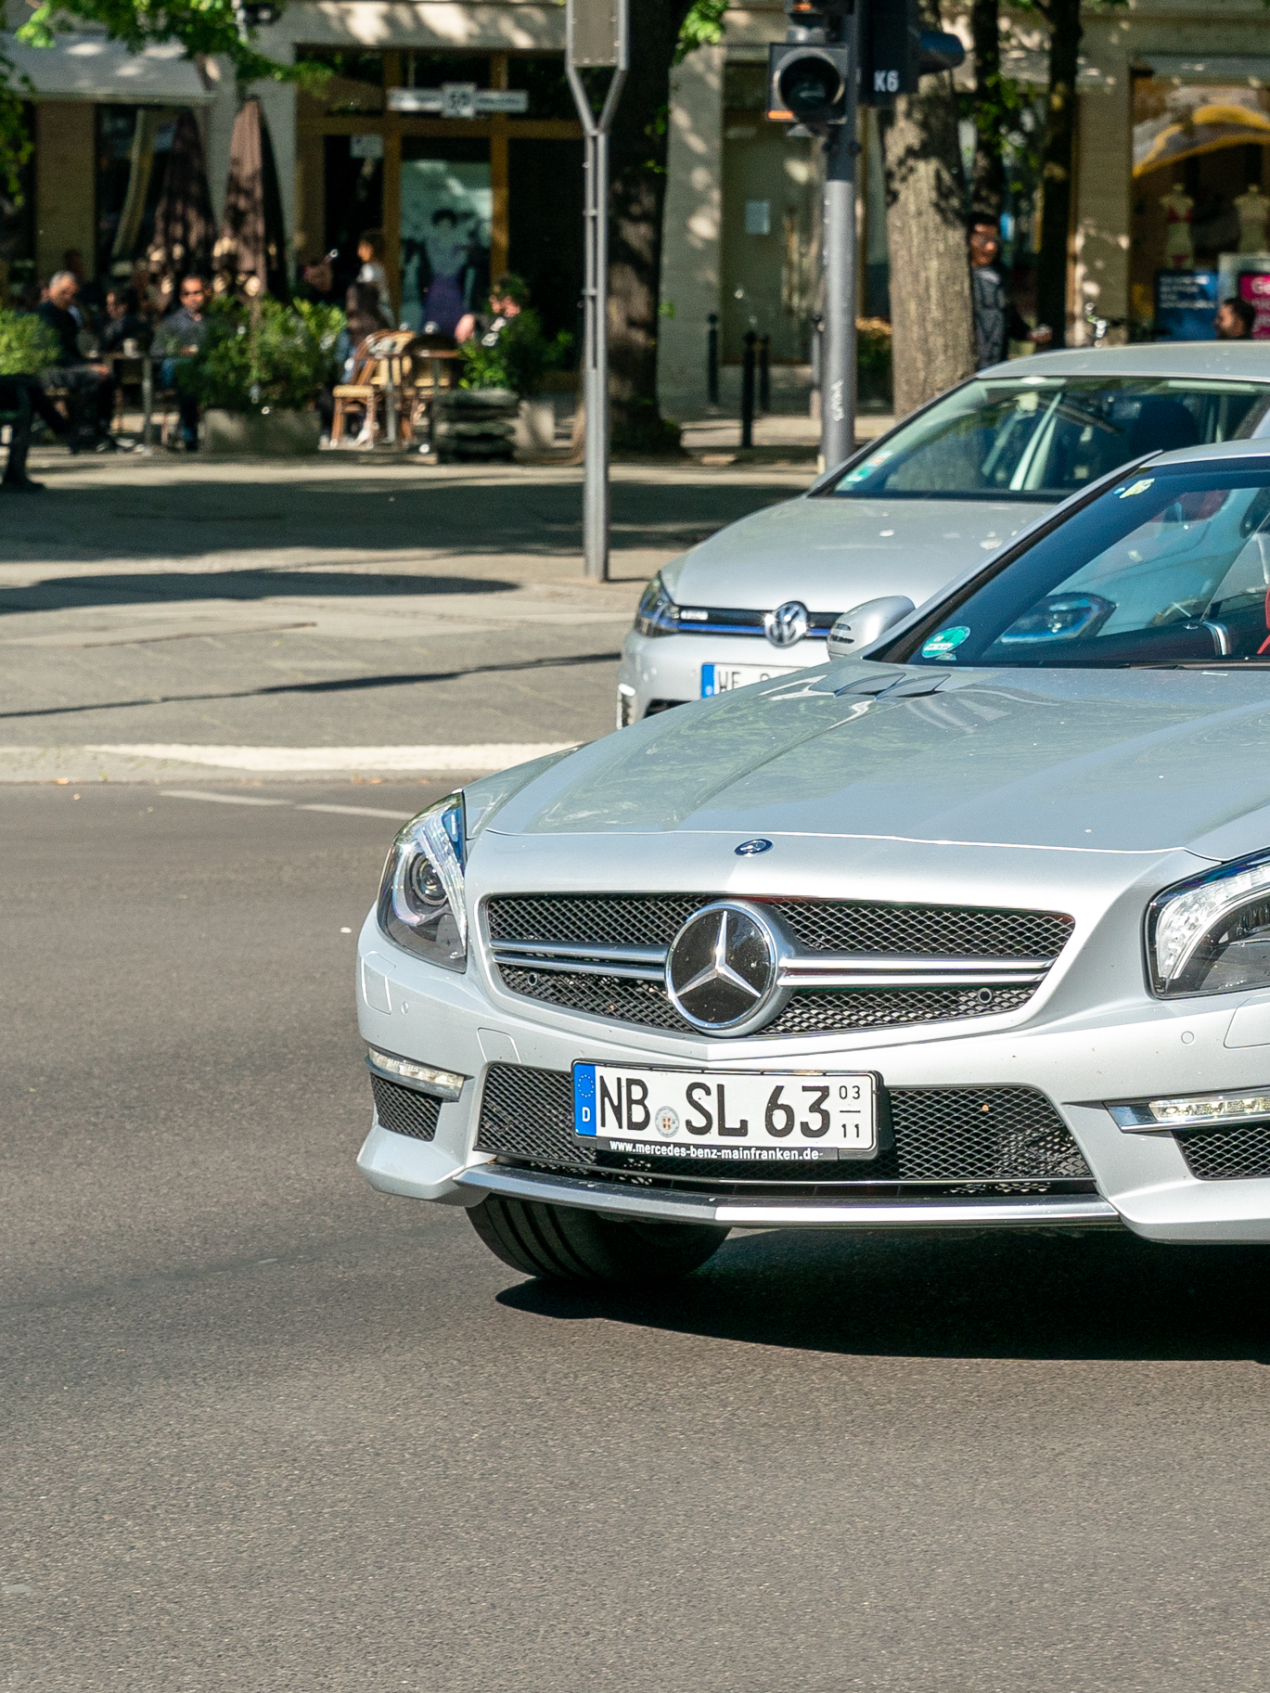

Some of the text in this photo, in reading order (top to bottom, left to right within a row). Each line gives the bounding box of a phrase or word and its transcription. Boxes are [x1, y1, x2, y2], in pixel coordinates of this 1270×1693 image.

[874, 70, 899, 92] K6
[838, 1085, 861, 1100] 03
[581, 1106, 591, 1122] D
[599, 1075, 831, 1138] NB SL 63
[841, 1123, 860, 1139] 11
